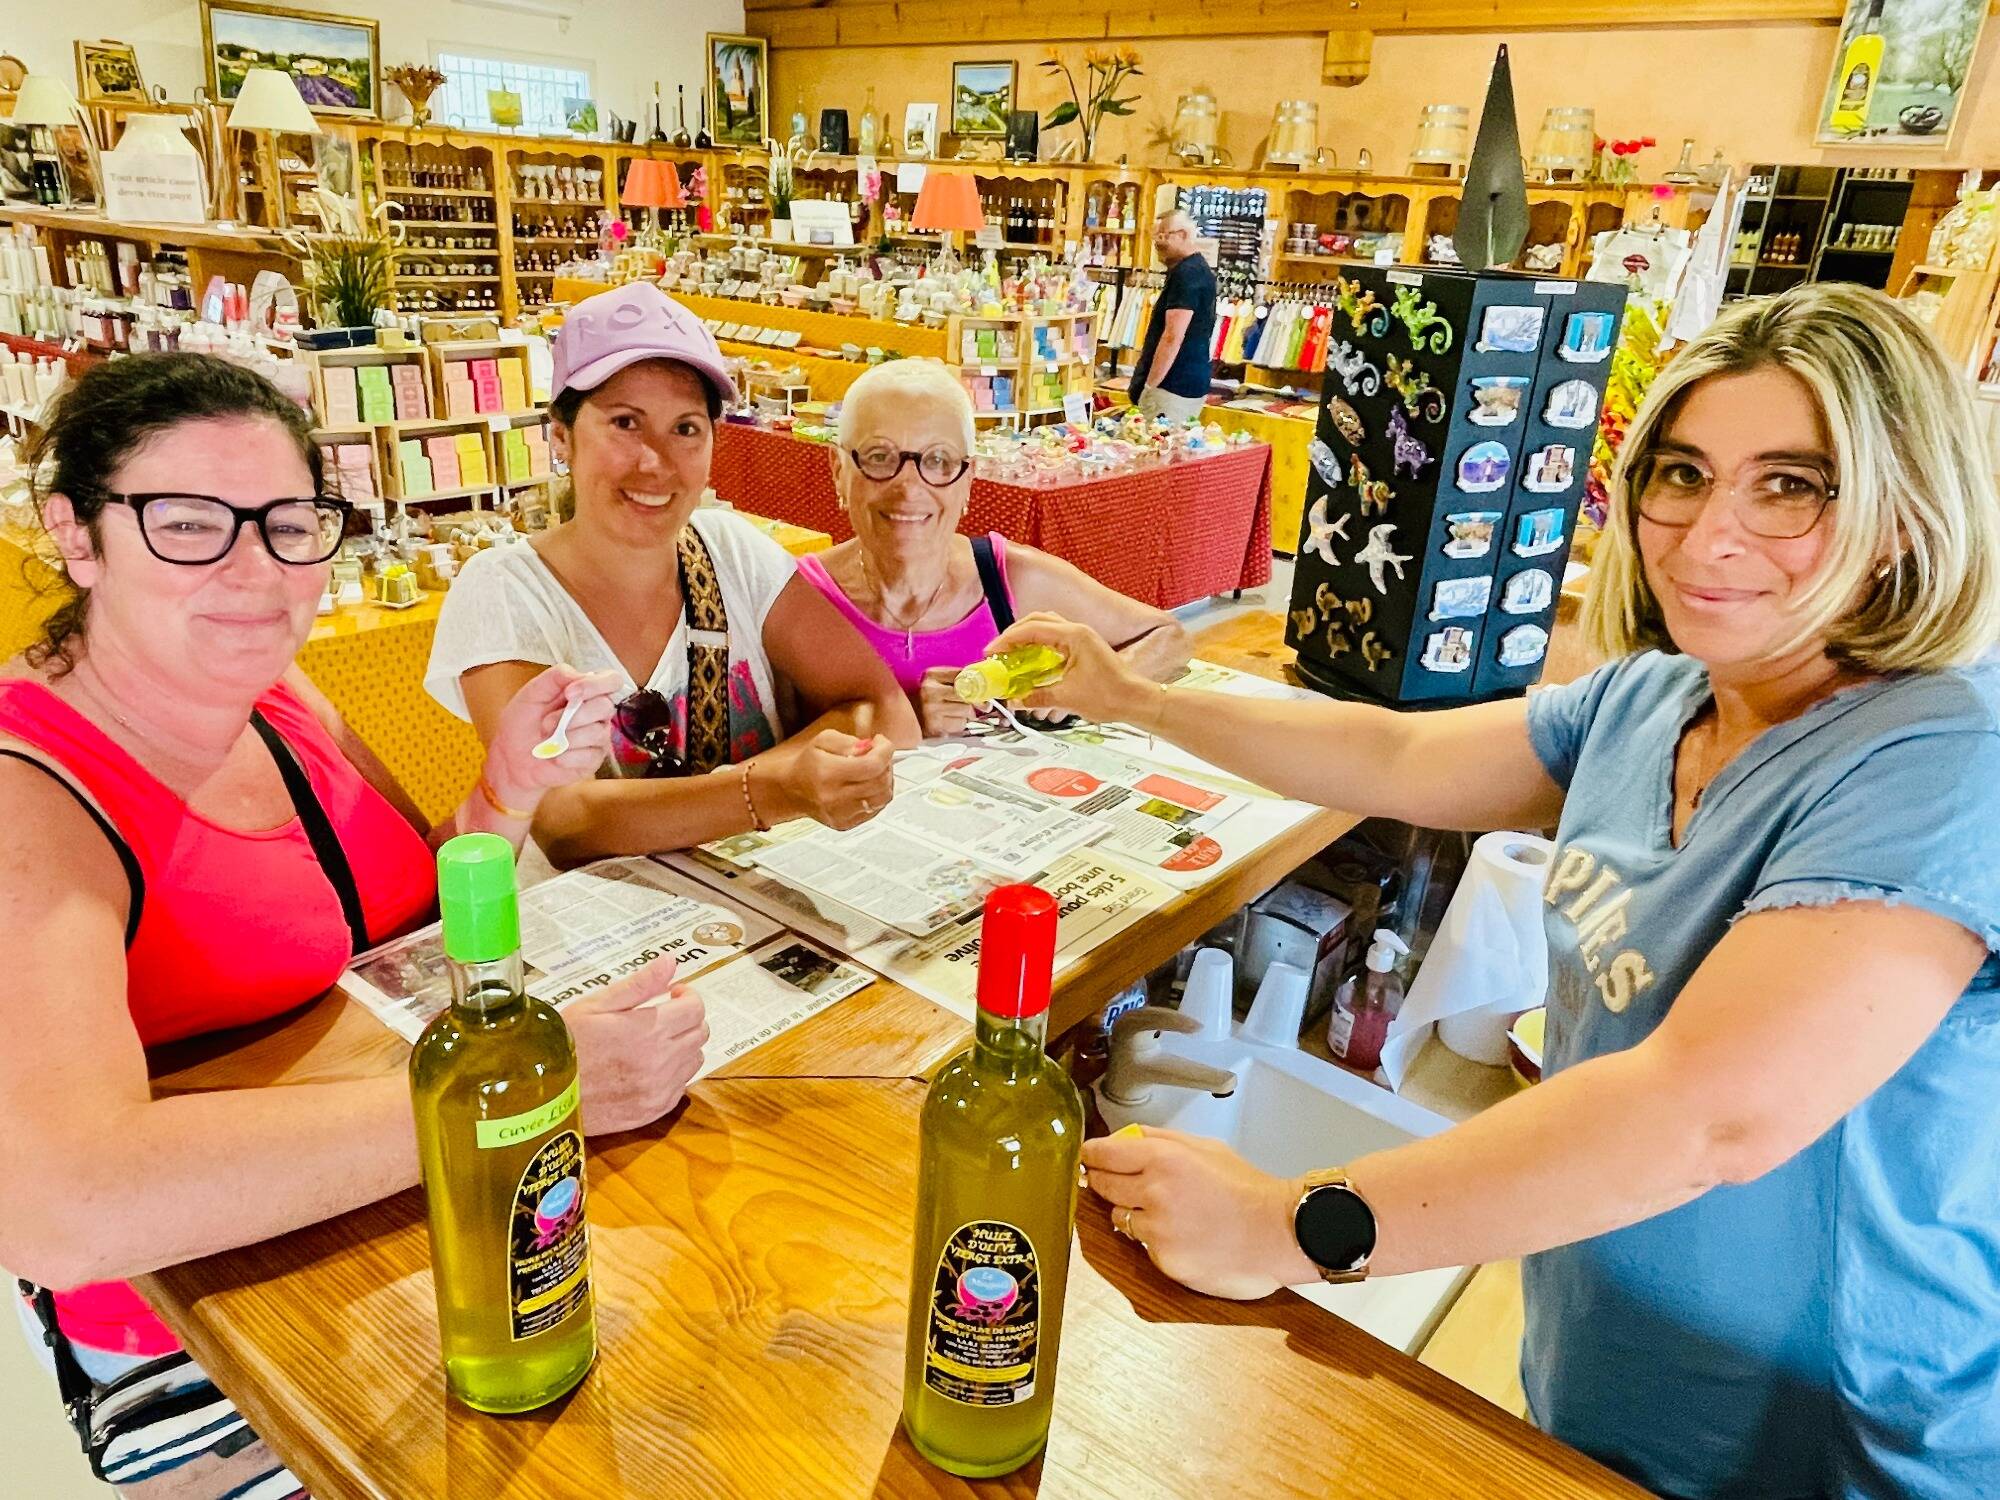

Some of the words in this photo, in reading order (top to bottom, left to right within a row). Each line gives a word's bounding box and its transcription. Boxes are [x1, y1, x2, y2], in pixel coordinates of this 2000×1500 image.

[1075, 866, 1106, 884] une
[1108, 873, 1127, 884] 5
[1086, 881, 1115, 898] clés
[659, 938, 687, 952] au
[611, 948, 660, 975] goût
[675, 948, 708, 965] Un
[582, 972, 612, 989] du
[973, 1228, 1013, 1241] HUILE
[948, 1243, 991, 1264] VIERGE
[993, 1251, 1034, 1265] EXTRA
[967, 1239, 1017, 1253] D'OLIVE
